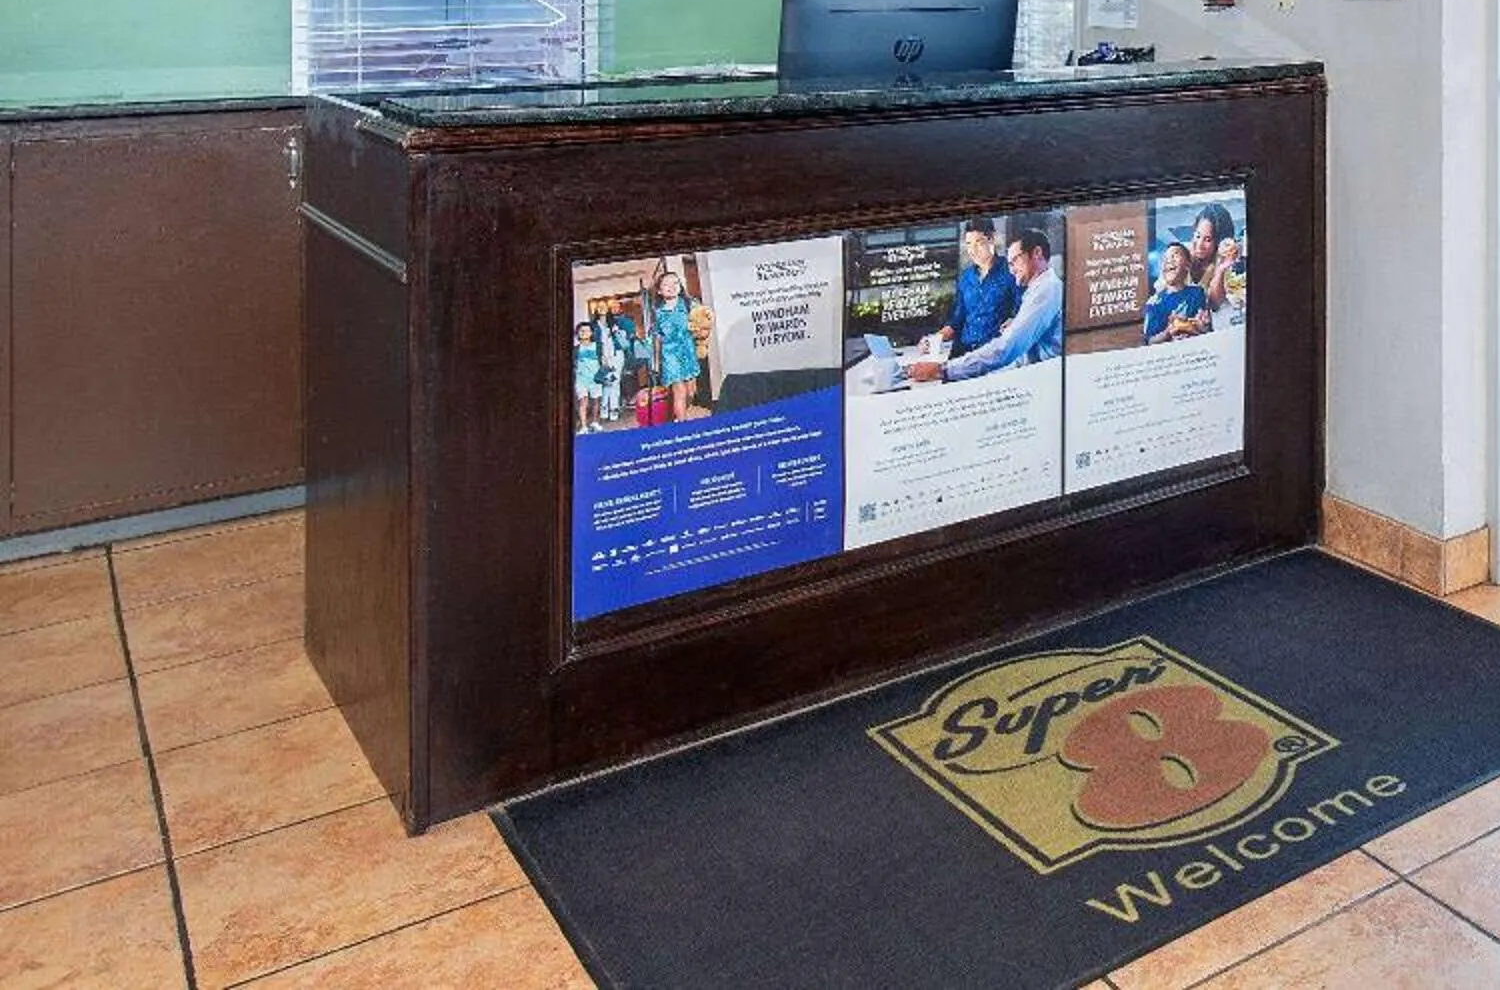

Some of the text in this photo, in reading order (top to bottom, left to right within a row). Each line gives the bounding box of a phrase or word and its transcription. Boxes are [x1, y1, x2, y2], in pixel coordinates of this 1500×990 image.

[751, 303, 809, 323] WYNDHAM
[755, 317, 807, 335] REWARDS
[932, 658, 1270, 828] Super 8
[1086, 772, 1407, 924] Welcome
